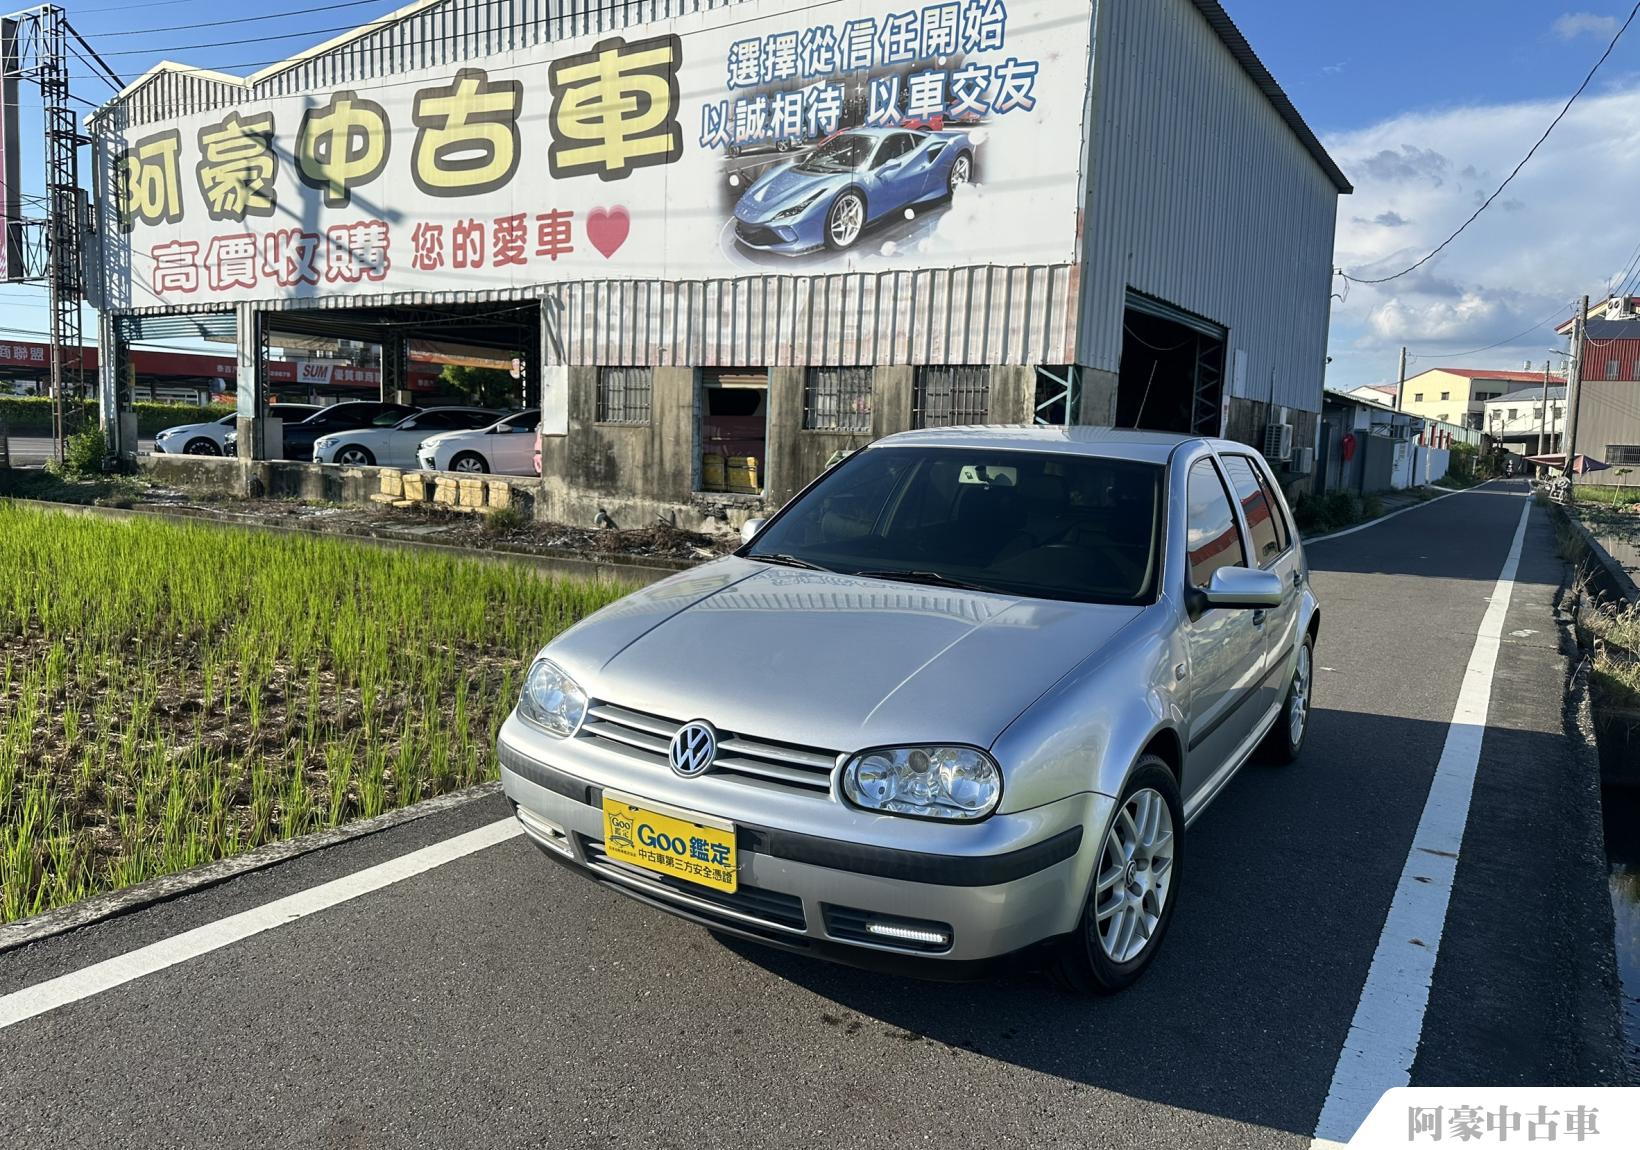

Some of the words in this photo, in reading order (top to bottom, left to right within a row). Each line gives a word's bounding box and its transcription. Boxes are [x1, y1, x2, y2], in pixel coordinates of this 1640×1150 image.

[727, 0, 1008, 89] 選擇從信任開始
[115, 34, 682, 235] 阿豪中古車
[699, 84, 844, 149] 以誠相待
[862, 57, 1040, 130] 以車交友
[151, 219, 391, 294] 高價收購
[410, 208, 575, 271] 您的愛車
[303, 365, 328, 378] SUM
[611, 817, 631, 830] Goo
[637, 823, 687, 855] Goo
[689, 836, 731, 867] 鑑定
